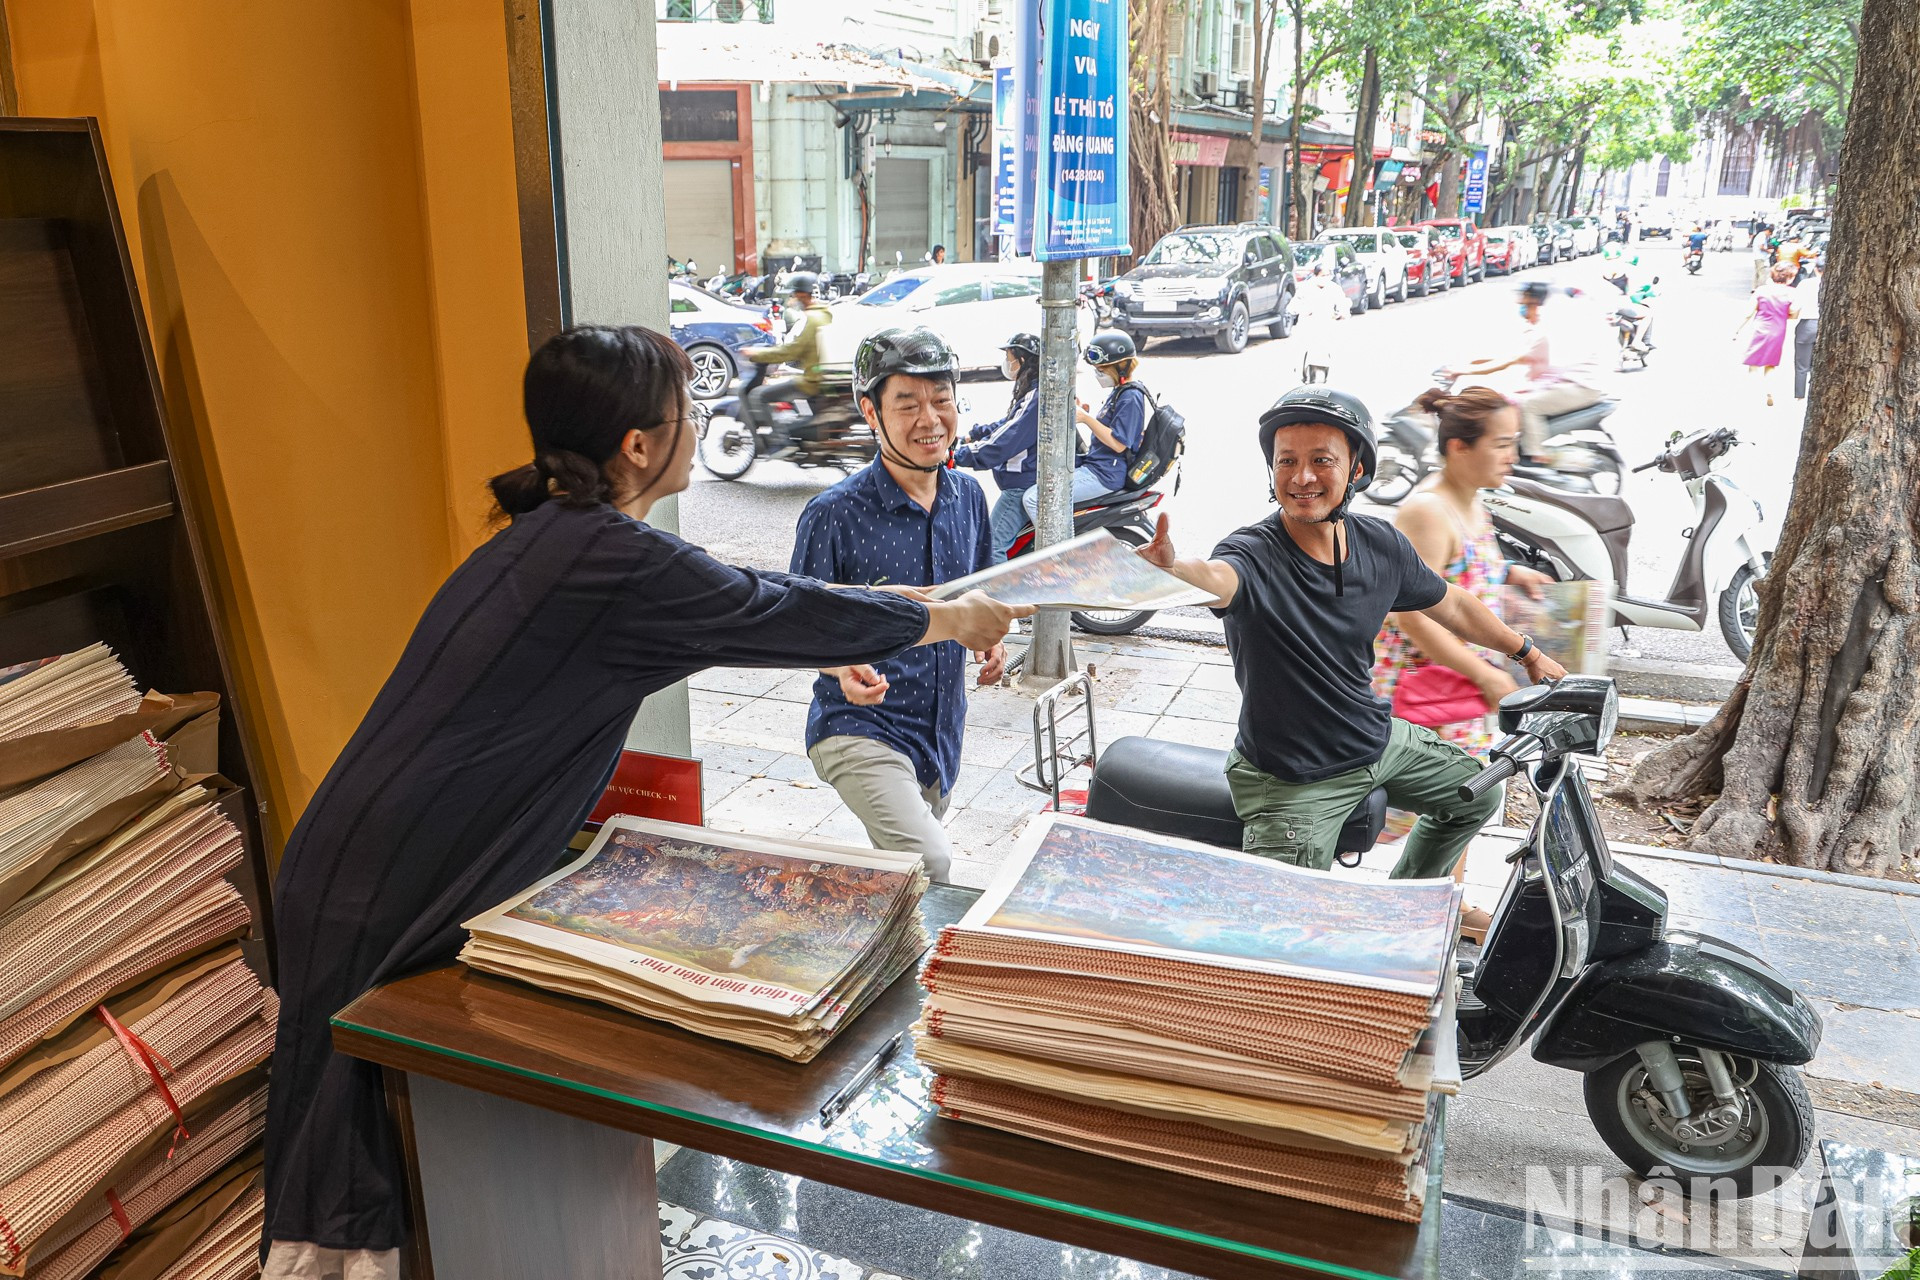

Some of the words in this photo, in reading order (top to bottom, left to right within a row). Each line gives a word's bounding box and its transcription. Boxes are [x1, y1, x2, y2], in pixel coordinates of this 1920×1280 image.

[1074, 56, 1097, 77] VUA
[1054, 92, 1066, 116] LÊ
[1068, 95, 1096, 118] THÁI
[1052, 130, 1083, 153] ĐĂNG
[636, 788, 662, 799] CHECK
[1562, 853, 1590, 882] vespa
[673, 967, 711, 986] Biên
[710, 977, 749, 993] Điện
[749, 985, 789, 999] dịch
